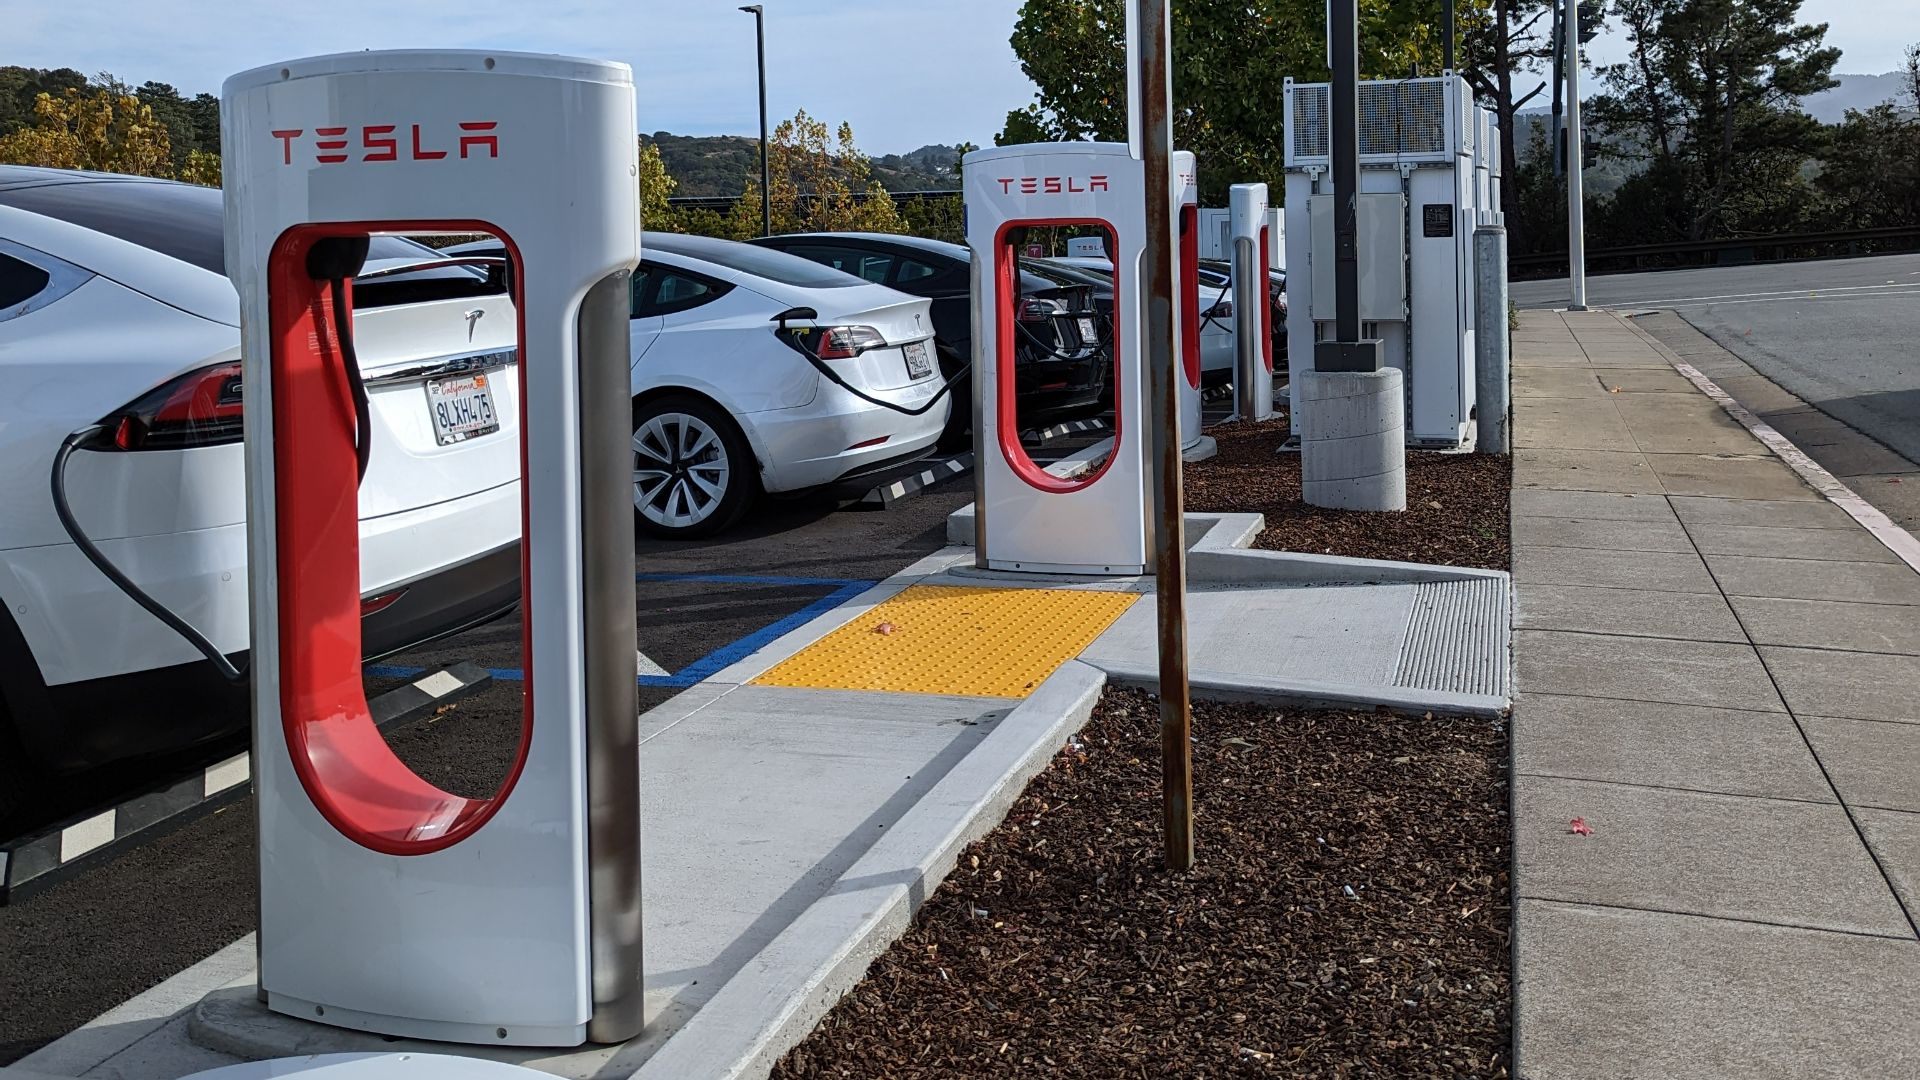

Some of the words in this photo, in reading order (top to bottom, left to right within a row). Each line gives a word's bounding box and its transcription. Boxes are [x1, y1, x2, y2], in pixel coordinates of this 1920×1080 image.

[271, 122, 498, 165] TESLA
[997, 176, 1108, 195] TESLA
[441, 380, 478, 397] California
[436, 393, 491, 428] 8LXH475
